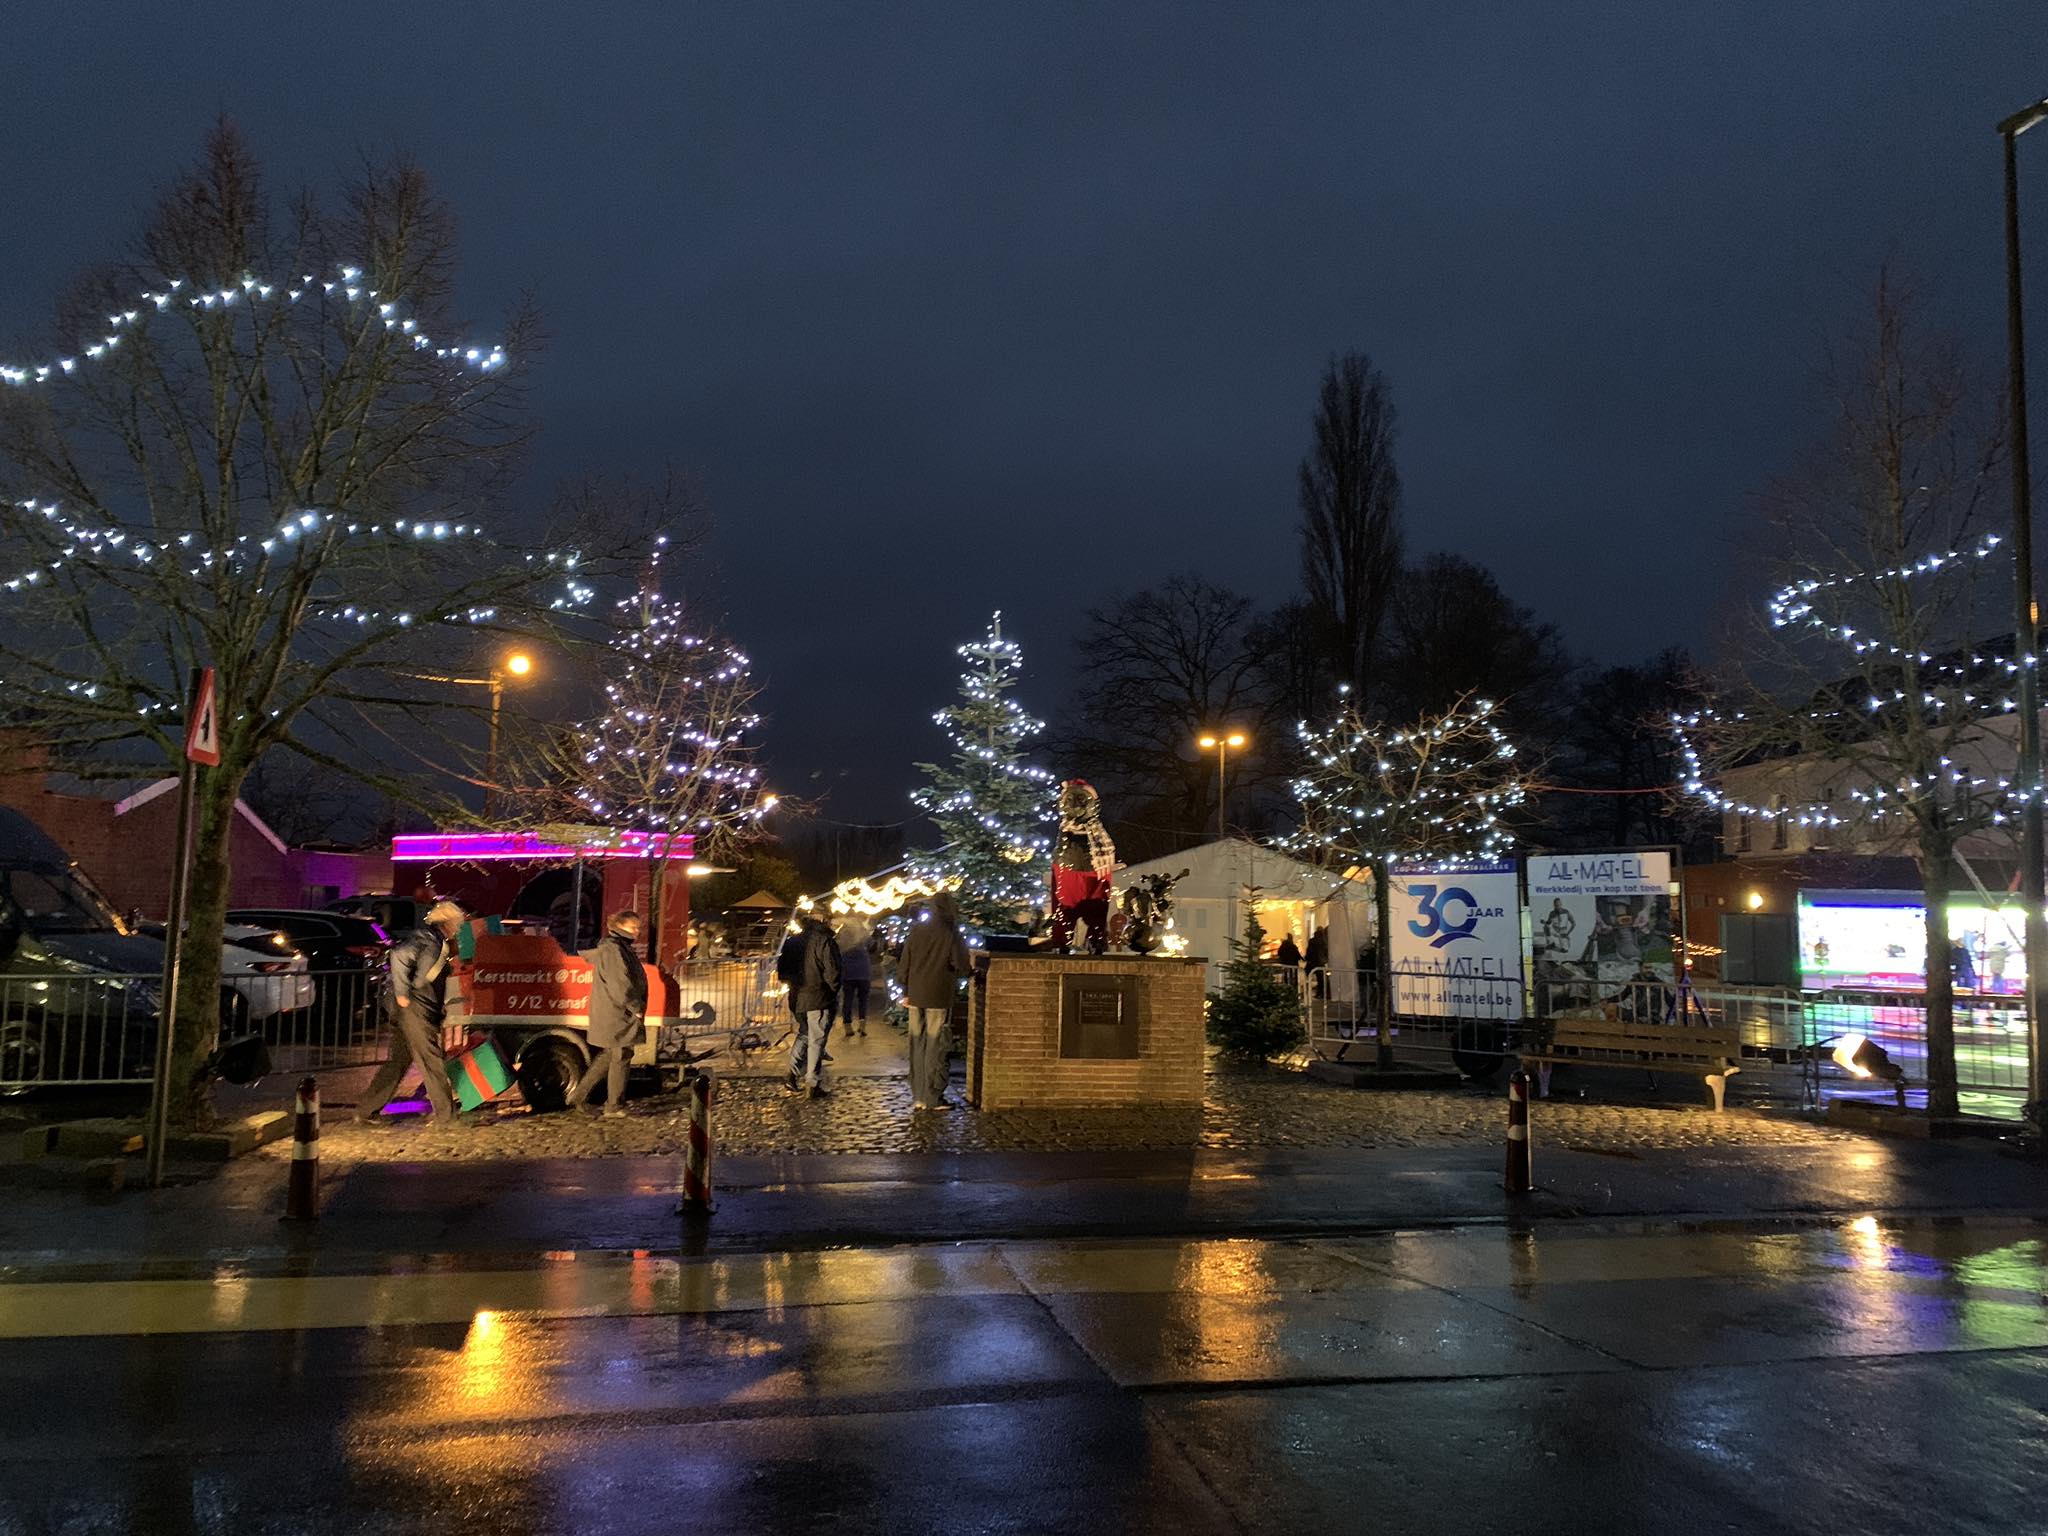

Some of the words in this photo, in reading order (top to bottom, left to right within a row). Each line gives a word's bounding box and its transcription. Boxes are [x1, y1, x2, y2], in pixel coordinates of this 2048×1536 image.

[1535, 885, 1582, 894] Werkkledij
[1604, 885, 1620, 894] kop
[1624, 884, 1637, 892] tot
[1408, 884, 1478, 937] 30
[1466, 907, 1504, 918] JAAR
[473, 968, 553, 983] Kerstmarkt
[547, 994, 590, 1010] vanaf
[1400, 990, 1513, 1006] www.allmatel.be
